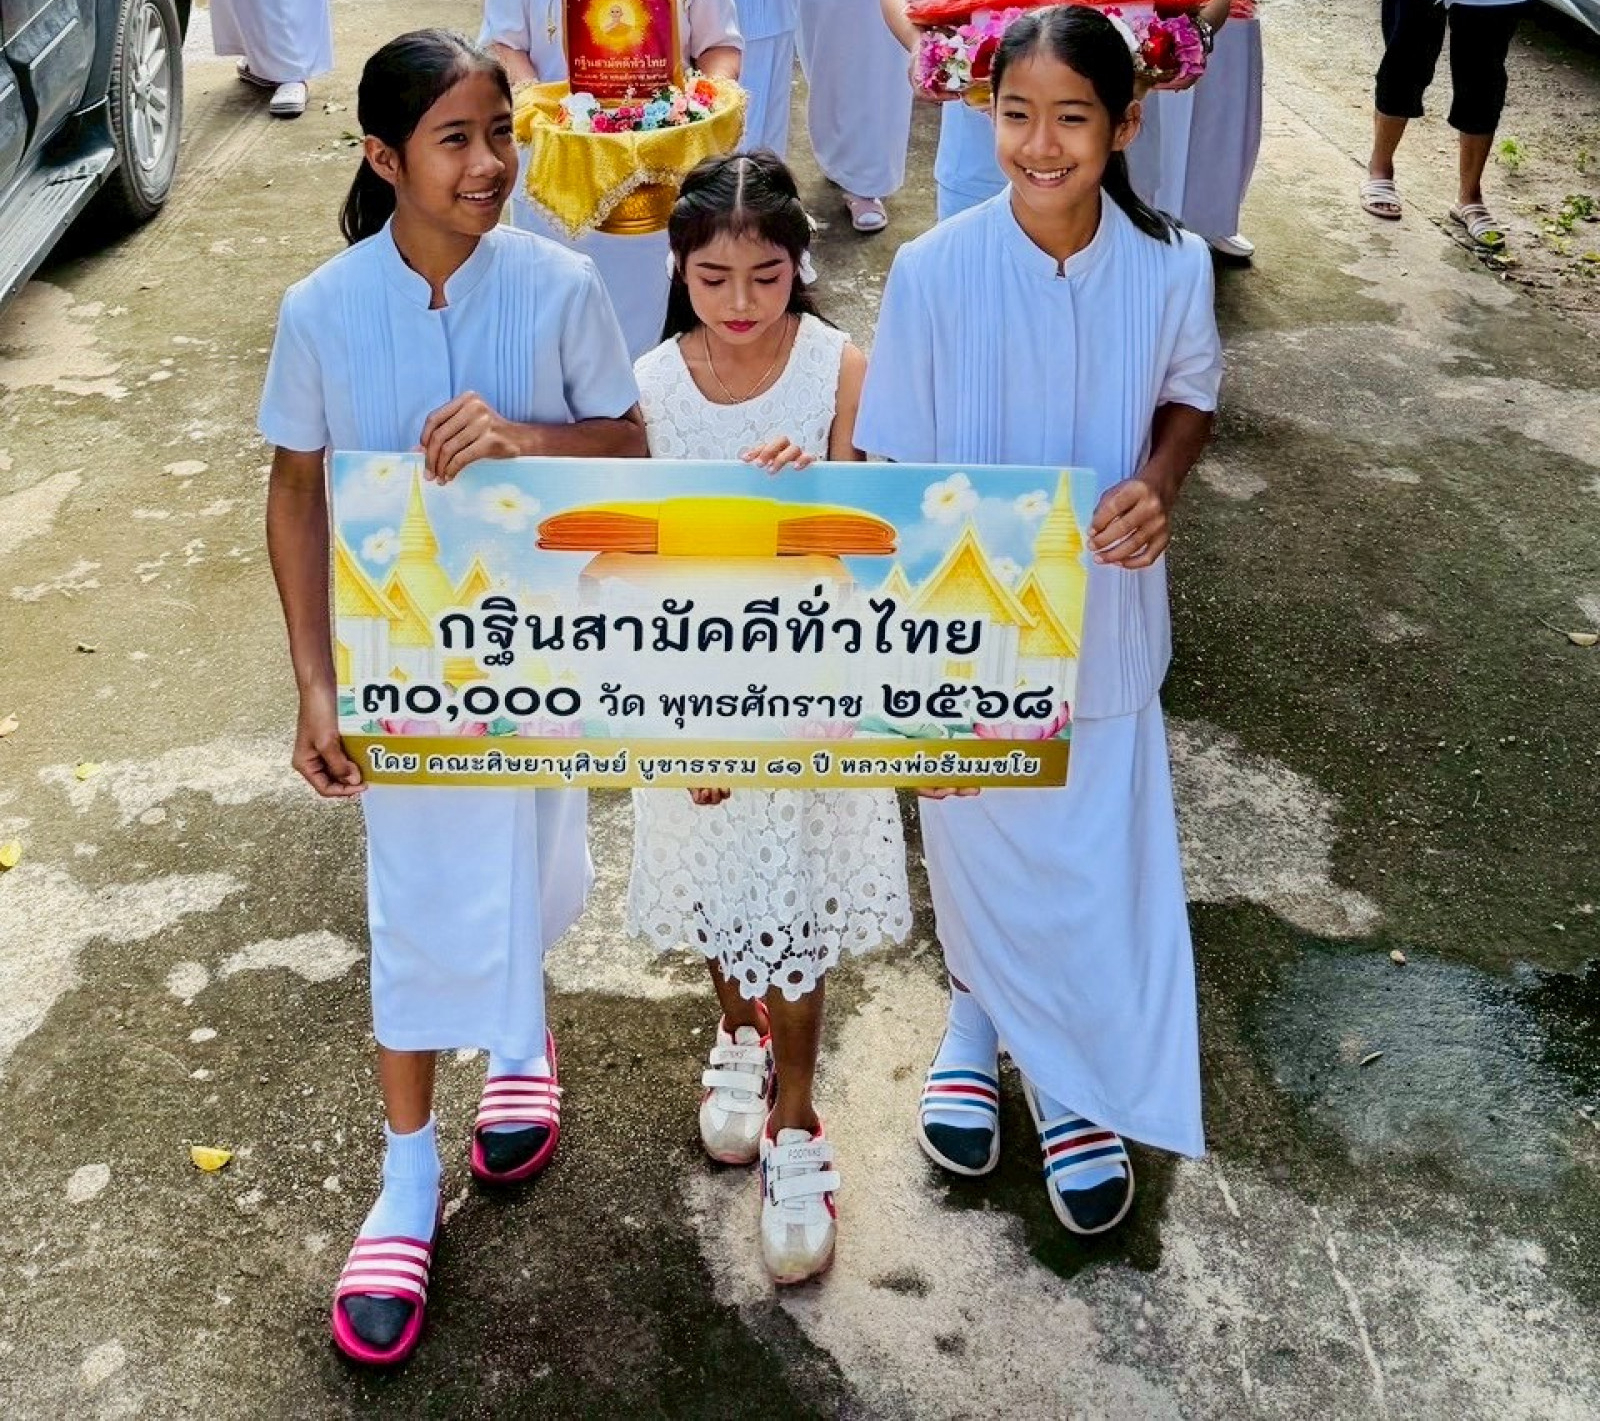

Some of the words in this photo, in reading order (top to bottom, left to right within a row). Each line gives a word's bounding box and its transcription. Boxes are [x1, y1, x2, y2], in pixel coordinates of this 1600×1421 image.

[438, 585, 982, 666] กฐินสามัคคีทั่วไทย
[362, 683, 581, 722] ๓๐,๐๐๐
[599, 682, 645, 717] วัด
[659, 683, 863, 729] พุทธศักราช
[881, 683, 1054, 719] ๒๕๖๘
[370, 748, 416, 770] โดย
[429, 750, 626, 780] คณะศิษยานุศิษย์
[637, 758, 756, 780] บูชาธรรม
[767, 759, 802, 775] ๘๑
[813, 752, 830, 774] ปี
[841, 752, 1039, 775] หลวงพ่อธัมมชโย
